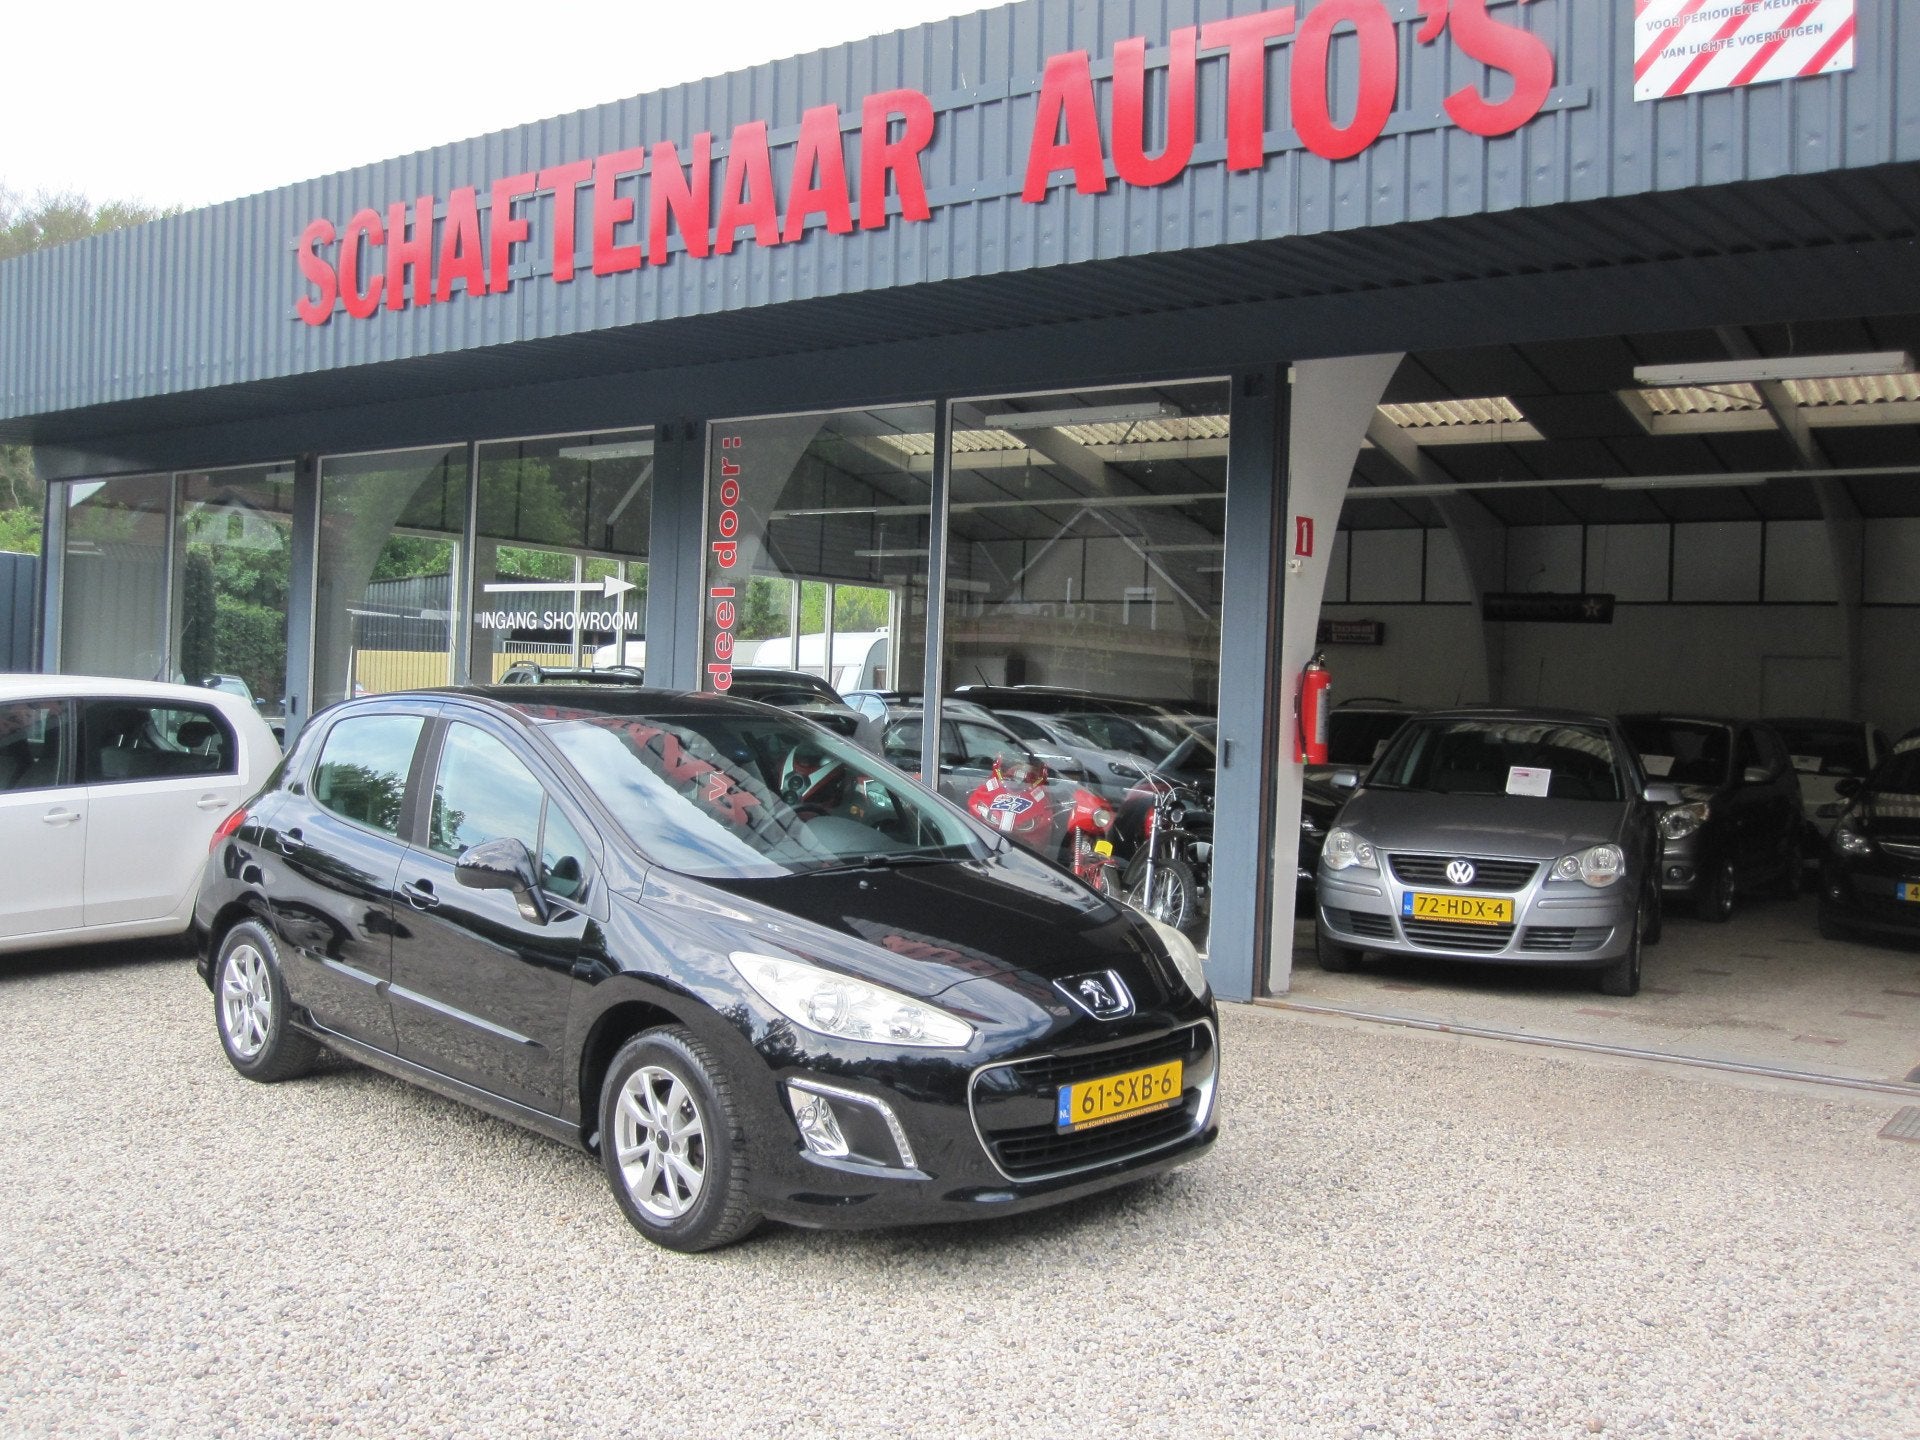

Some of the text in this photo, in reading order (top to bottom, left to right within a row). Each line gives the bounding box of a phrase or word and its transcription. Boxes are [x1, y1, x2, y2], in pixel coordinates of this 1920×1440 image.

[1646, 17, 1680, 32] VOOR
[1684, 4, 1760, 25] PERIODIEKE
[1661, 24, 1824, 60] VAN LICHTE VOERTUIGEN
[296, 0, 1555, 326] SCHAFTENAAR AUTO'S
[481, 611, 639, 630] INGANG SHOWROOM
[1418, 896, 1504, 918] 72-HDX-4
[1081, 1068, 1172, 1114] 61-SXB-6
[1059, 1110, 1070, 1119] NL
